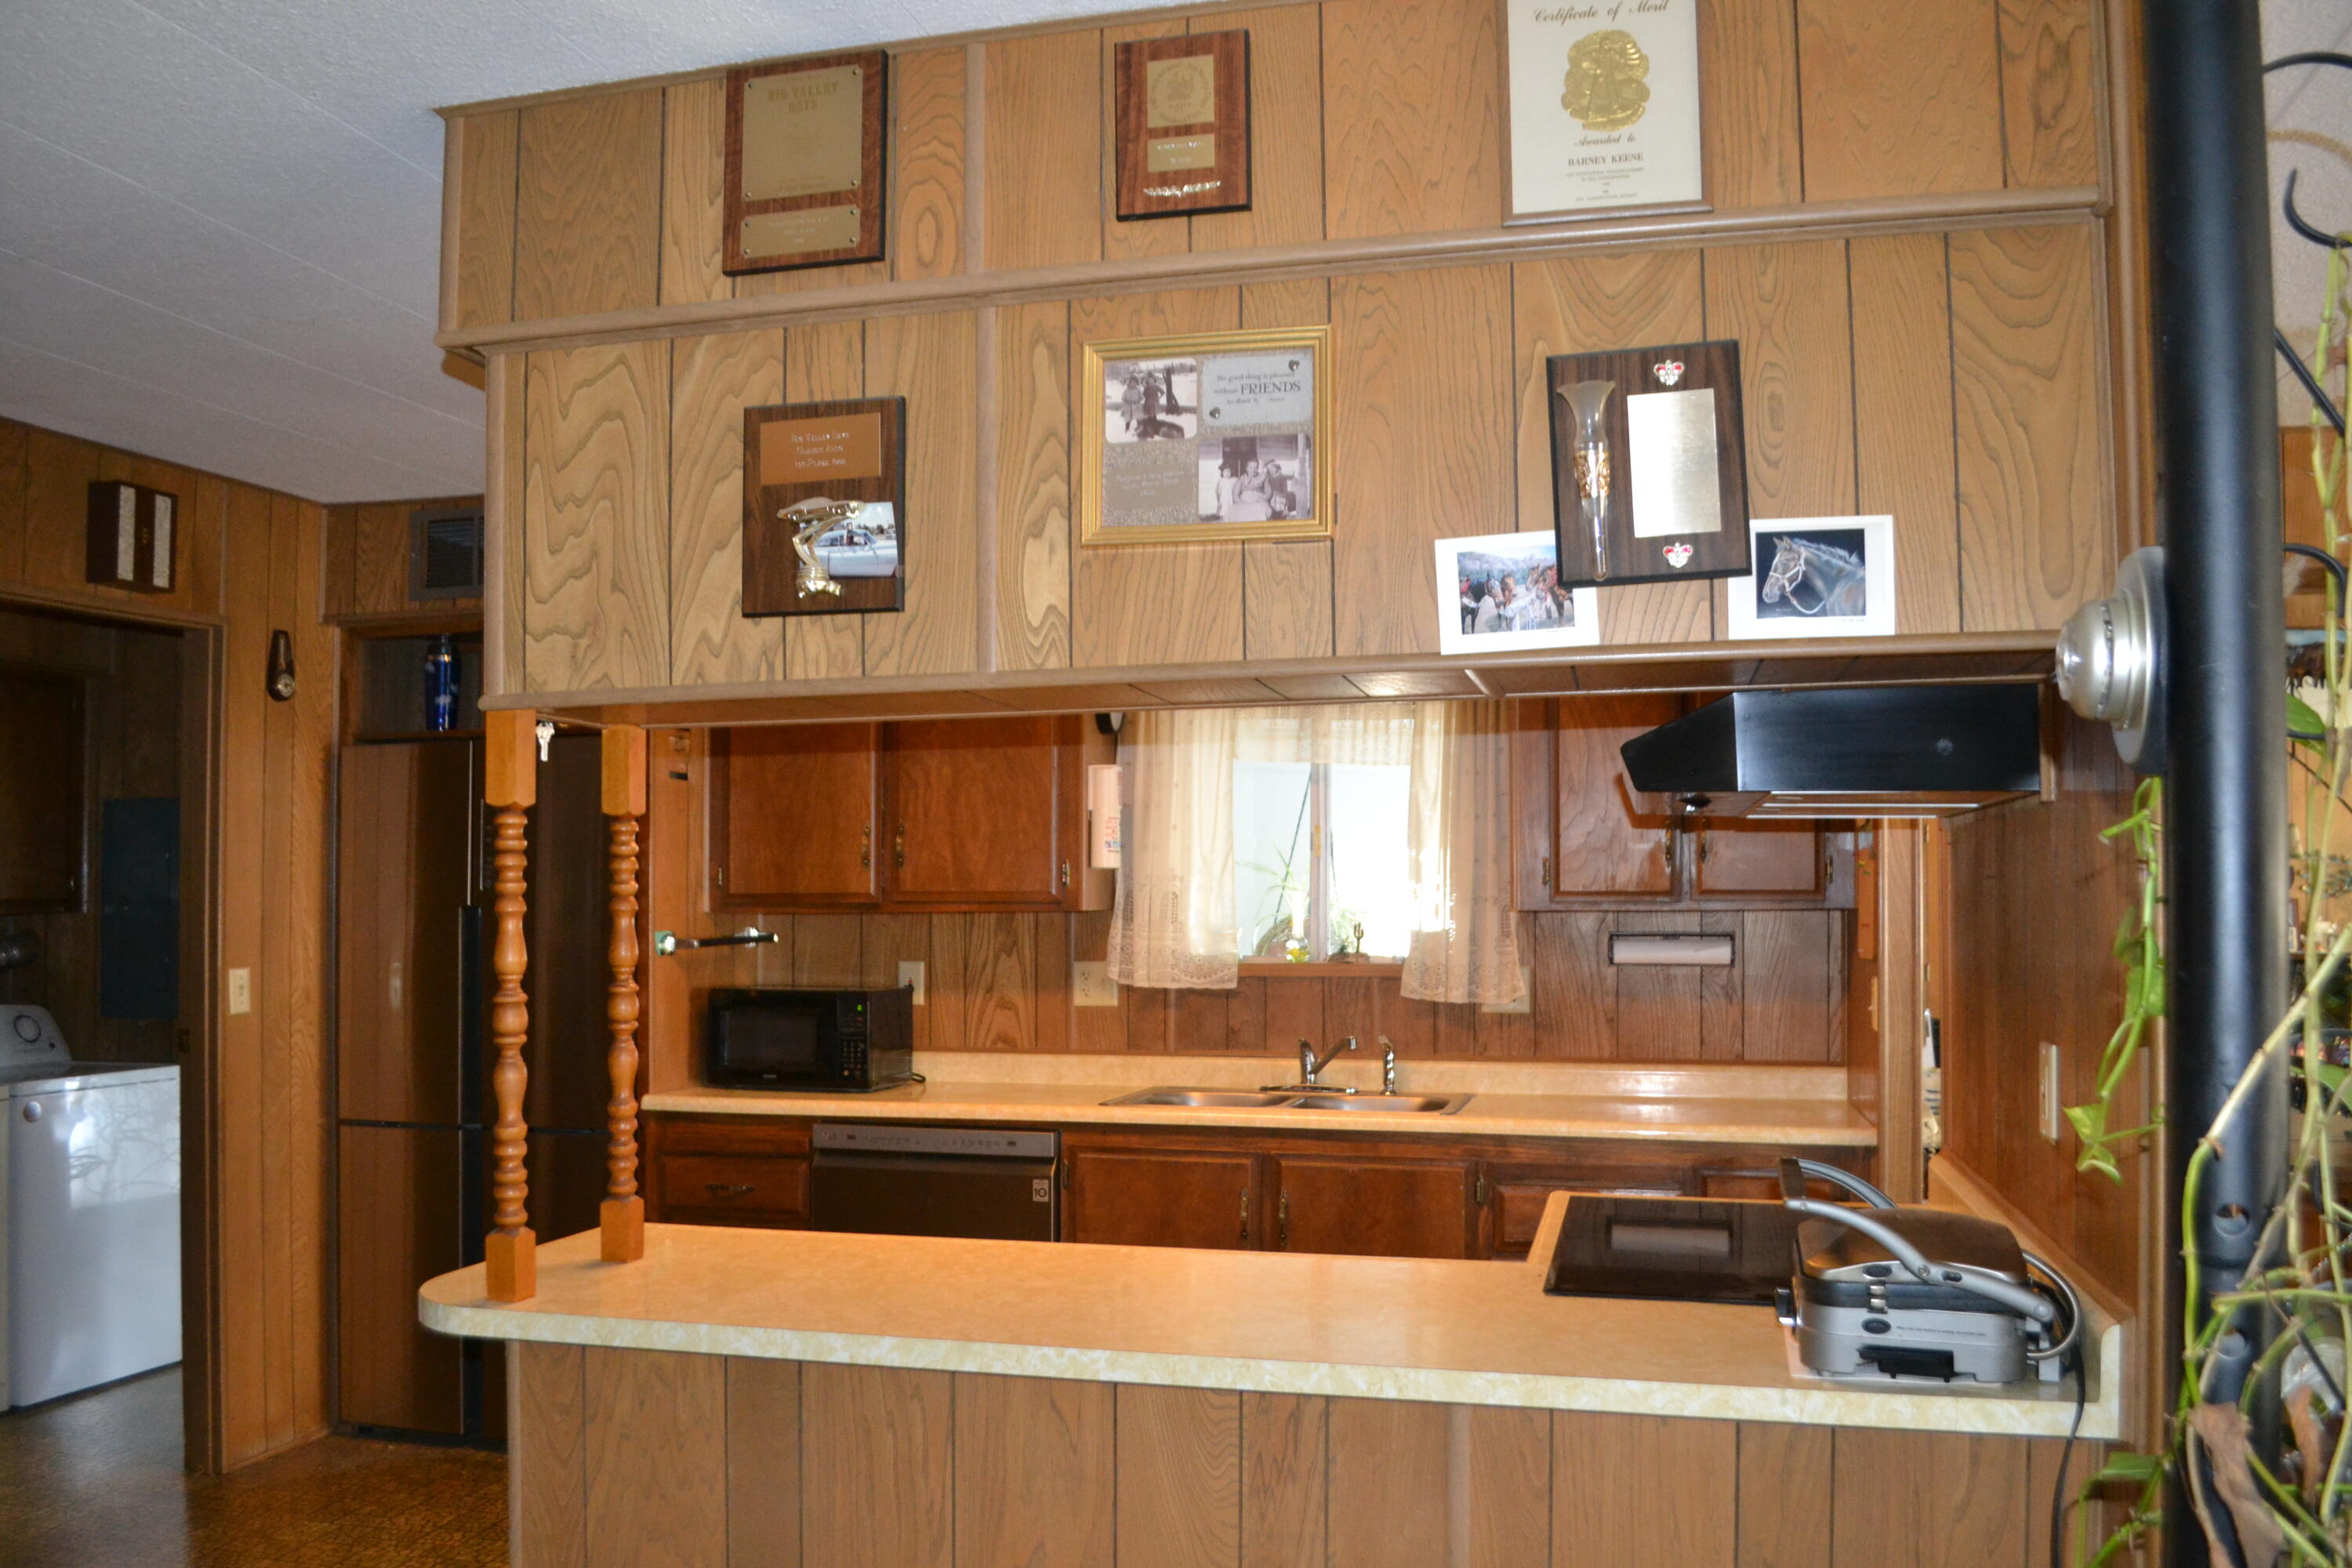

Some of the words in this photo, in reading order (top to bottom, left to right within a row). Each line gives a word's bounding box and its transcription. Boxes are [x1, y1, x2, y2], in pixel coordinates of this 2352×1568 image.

[1534, 4, 1599, 25] Certificate
[1607, 0, 1621, 21] of
[1574, 133, 1621, 147] Awarded
[1568, 155, 1606, 167] BARNEY
[1611, 152, 1644, 164] KEENE
[1240, 380, 1301, 395] FRIENDS
[1034, 1187, 1047, 1198] 10
